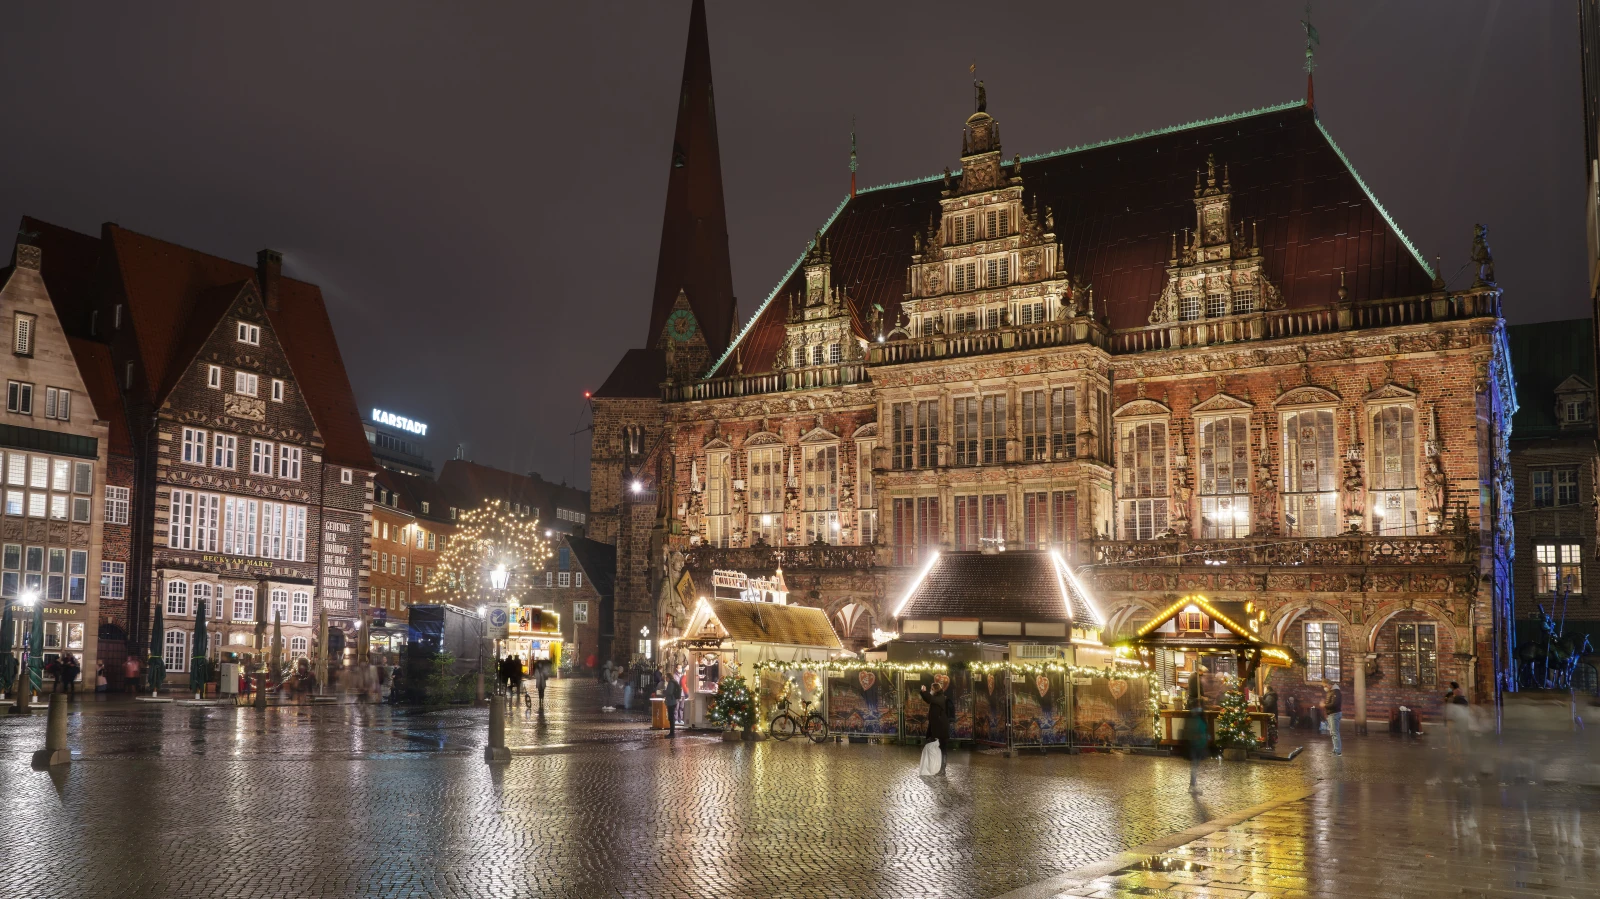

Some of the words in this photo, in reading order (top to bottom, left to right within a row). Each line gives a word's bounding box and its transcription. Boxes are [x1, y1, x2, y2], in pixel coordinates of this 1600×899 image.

[373, 408, 427, 436] KARSTADT
[247, 560, 273, 568] MARKT
[43, 607, 76, 615] BISTRO
